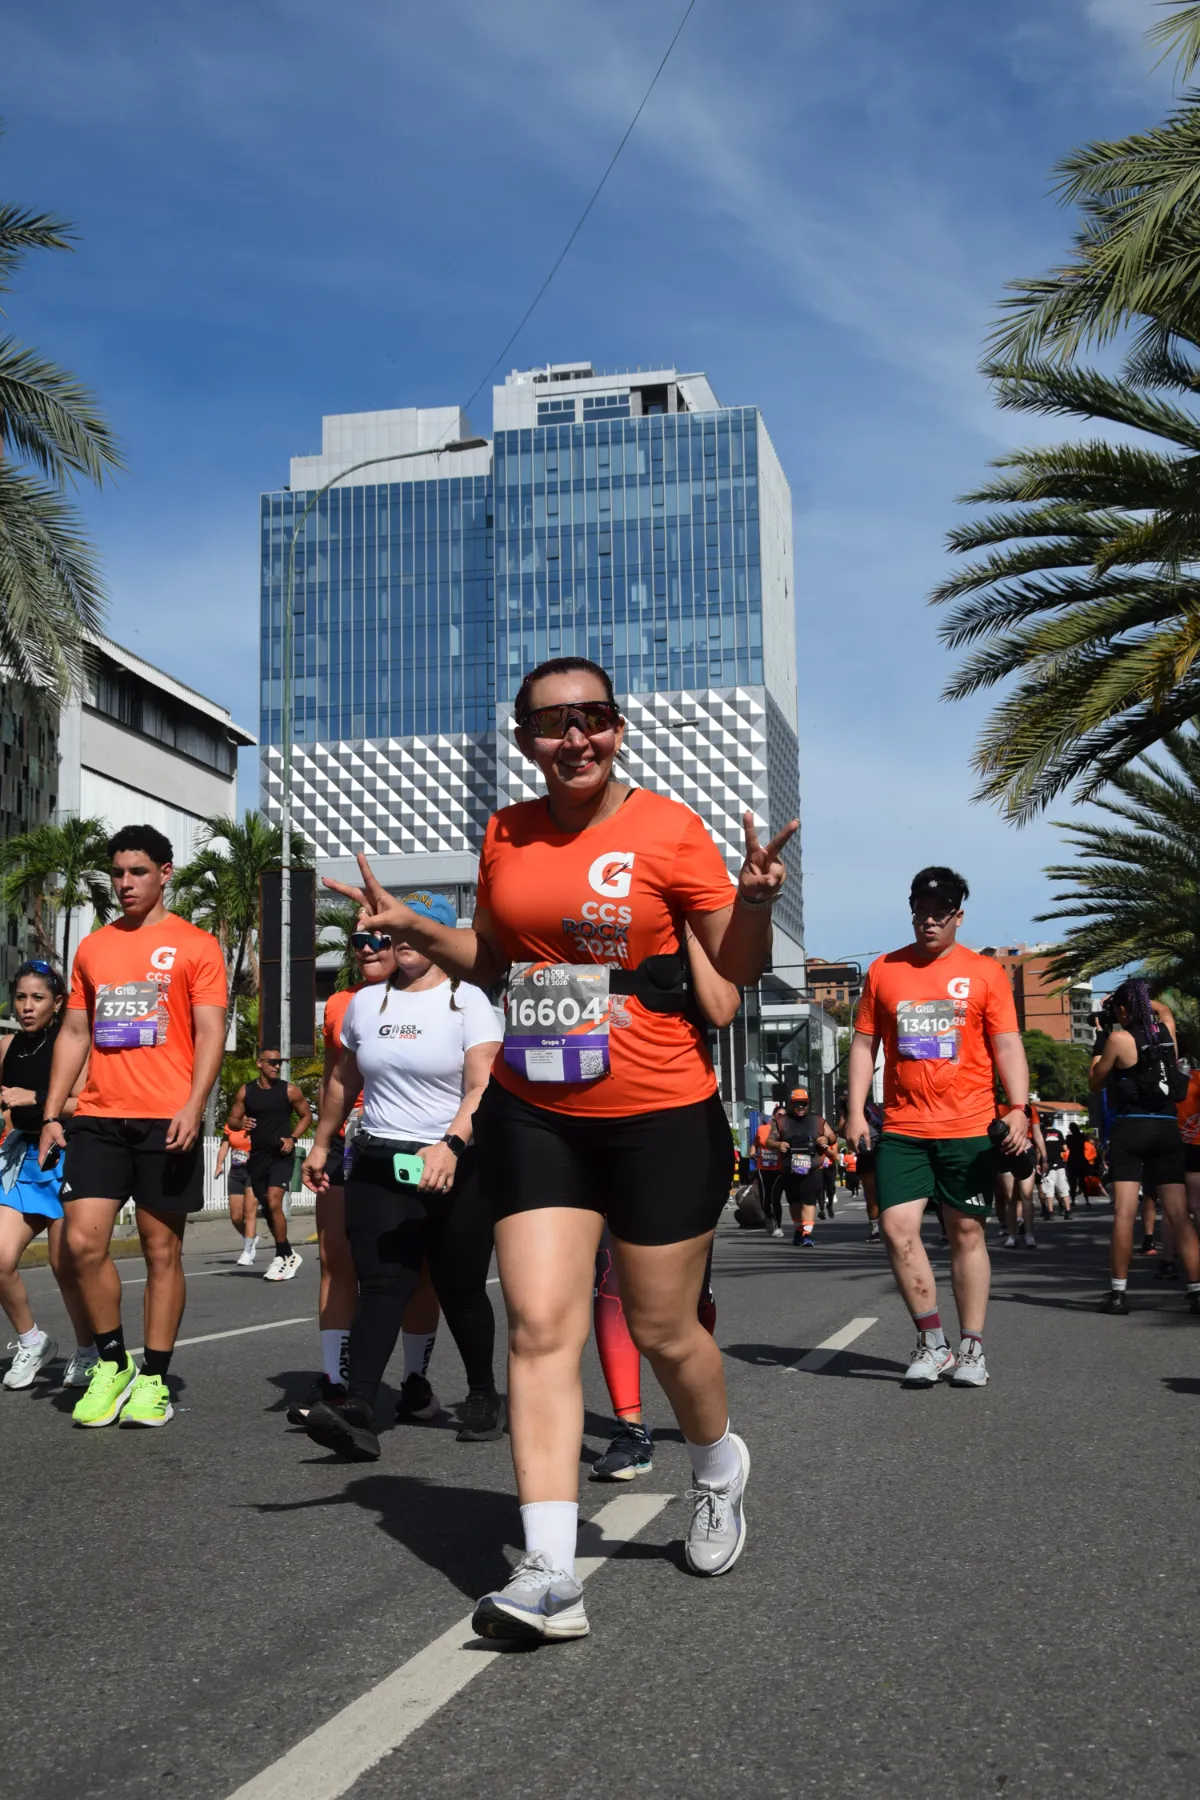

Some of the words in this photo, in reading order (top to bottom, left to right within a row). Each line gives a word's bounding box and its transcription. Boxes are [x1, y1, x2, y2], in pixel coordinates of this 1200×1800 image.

[581, 901, 632, 924] CCS
[561, 917, 630, 943] ROCK
[574, 936, 628, 959] 2026
[146, 972, 171, 984] CCS
[103, 1001, 149, 1016] 3753
[509, 997, 603, 1026] 16604
[954, 1000, 968, 1009] CS
[901, 1018, 950, 1032] 13410
